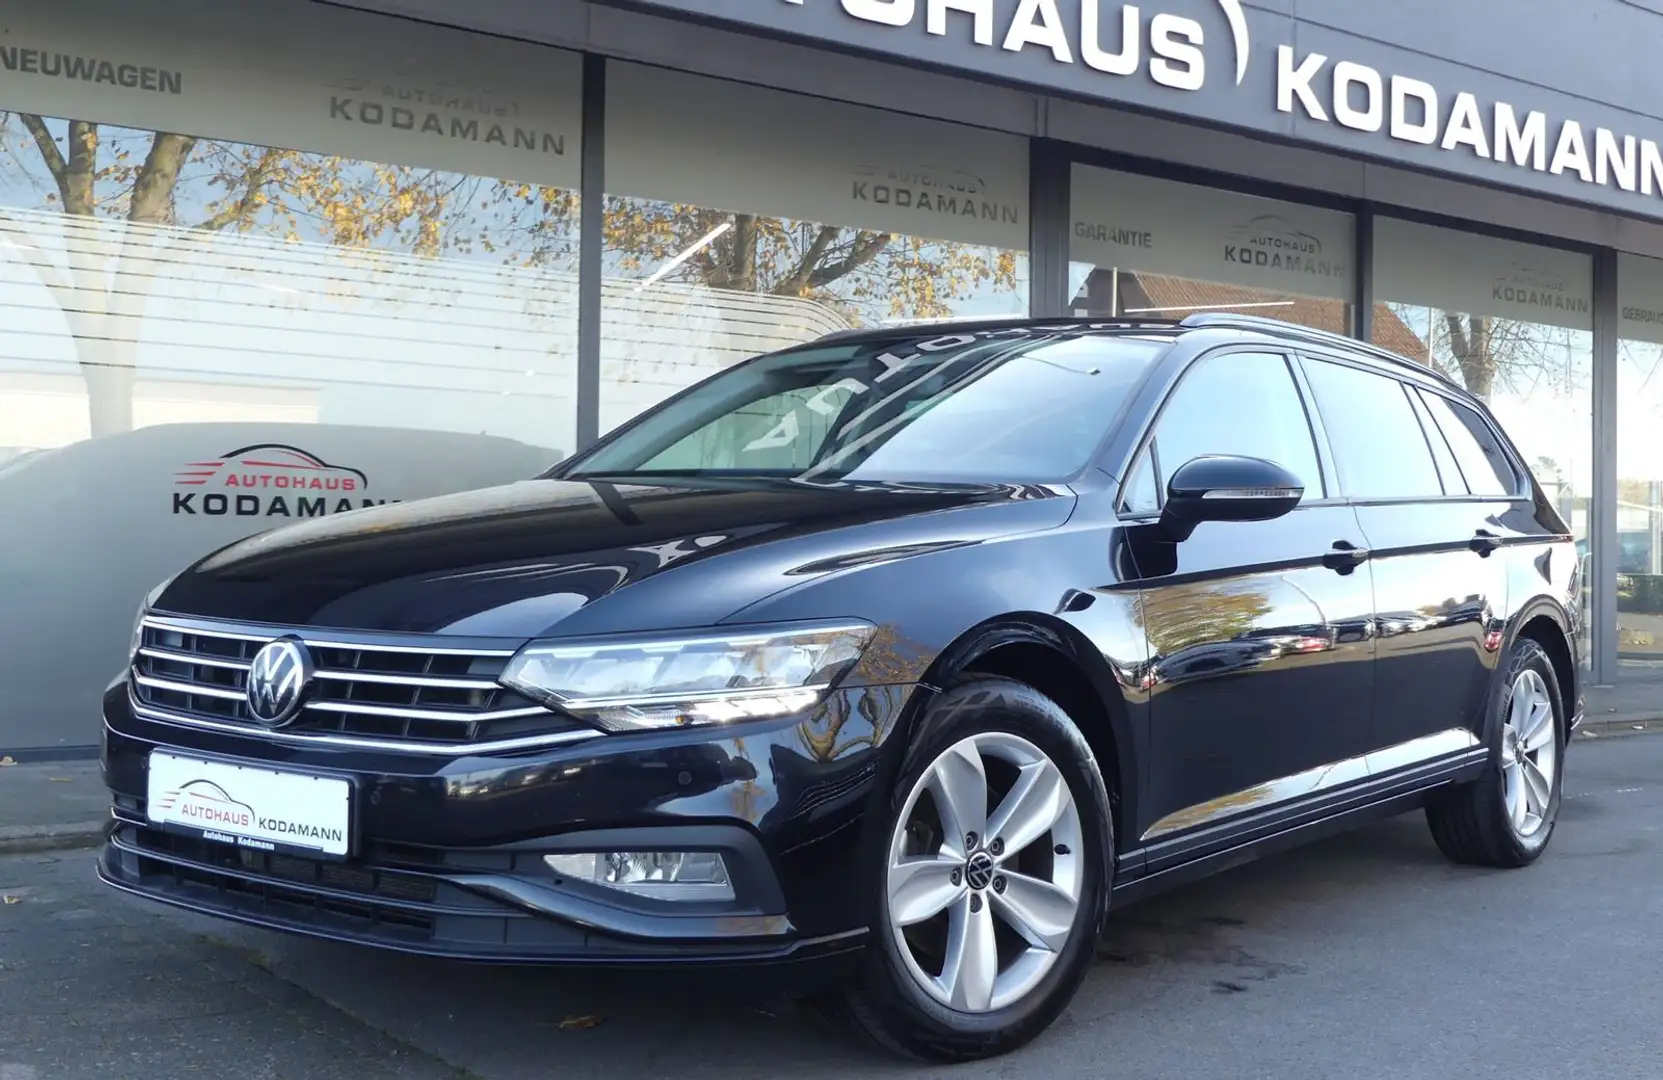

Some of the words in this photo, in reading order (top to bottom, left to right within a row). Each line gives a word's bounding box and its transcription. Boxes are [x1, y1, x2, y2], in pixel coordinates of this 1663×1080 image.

[0, 46, 182, 94] NEUWAGEN
[784, 0, 1205, 91] HAUS
[1277, 45, 1663, 197] KODAMANN
[330, 96, 564, 156] KODAMANN
[852, 181, 1019, 224] KODAMANN
[1074, 222, 1152, 248] GARANTIE
[1250, 236, 1316, 254] AUTOHAUS
[1224, 245, 1346, 278] KODAMANN
[1492, 283, 1588, 313] KODAMANN
[224, 473, 356, 491] AUTOHAUS
[172, 492, 402, 517] KODAMA
[181, 803, 249, 827] AUTOHAUS
[258, 816, 342, 842] KODAMANN
[203, 830, 235, 844] Autohaus
[237, 835, 275, 851] Kodamann
